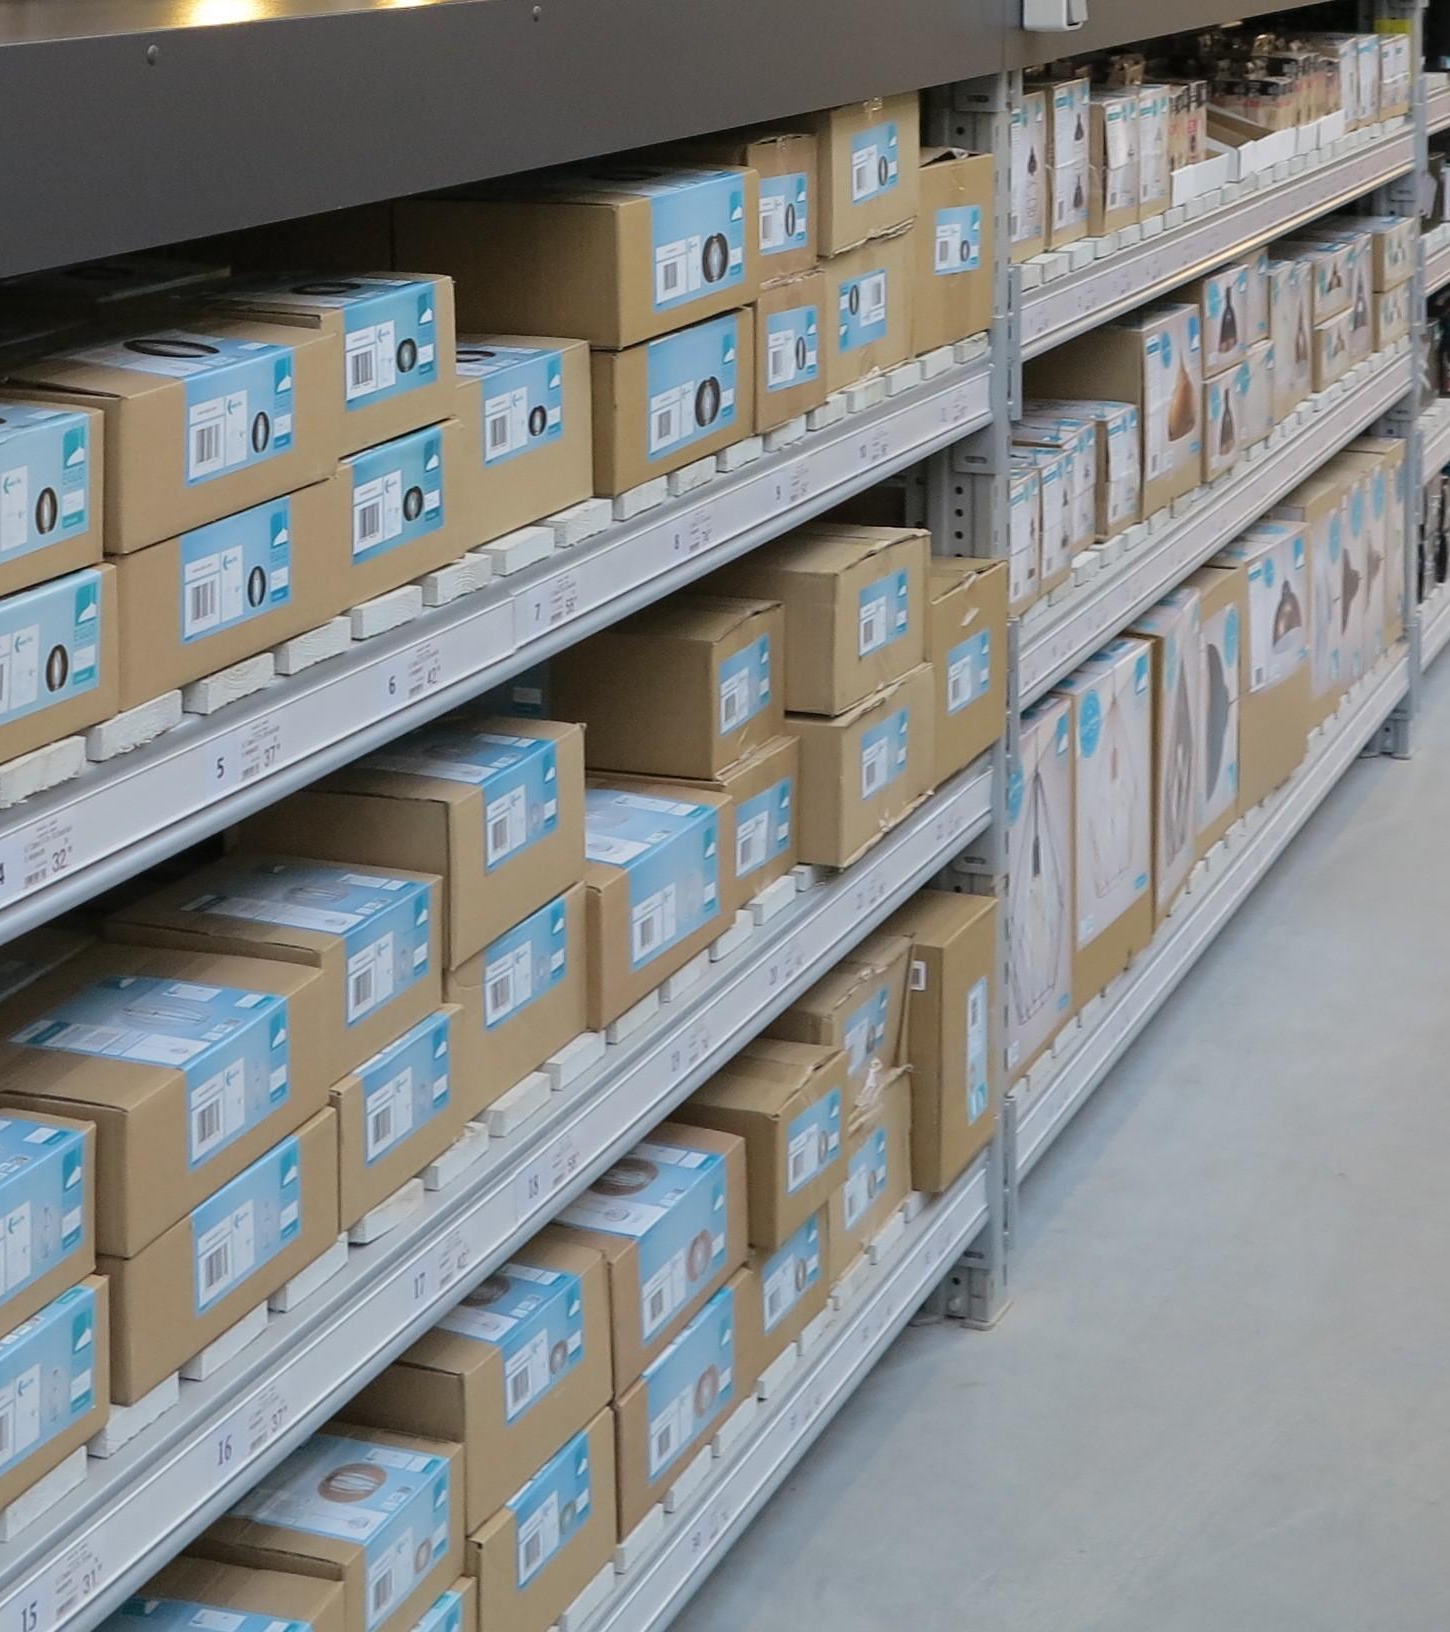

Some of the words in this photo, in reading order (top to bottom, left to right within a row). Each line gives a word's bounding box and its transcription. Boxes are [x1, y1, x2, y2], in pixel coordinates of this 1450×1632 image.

[388, 676, 397, 695] 6
[216, 757, 225, 779] 5
[217, 1434, 233, 1466] 16
[21, 1600, 38, 1632] 15
